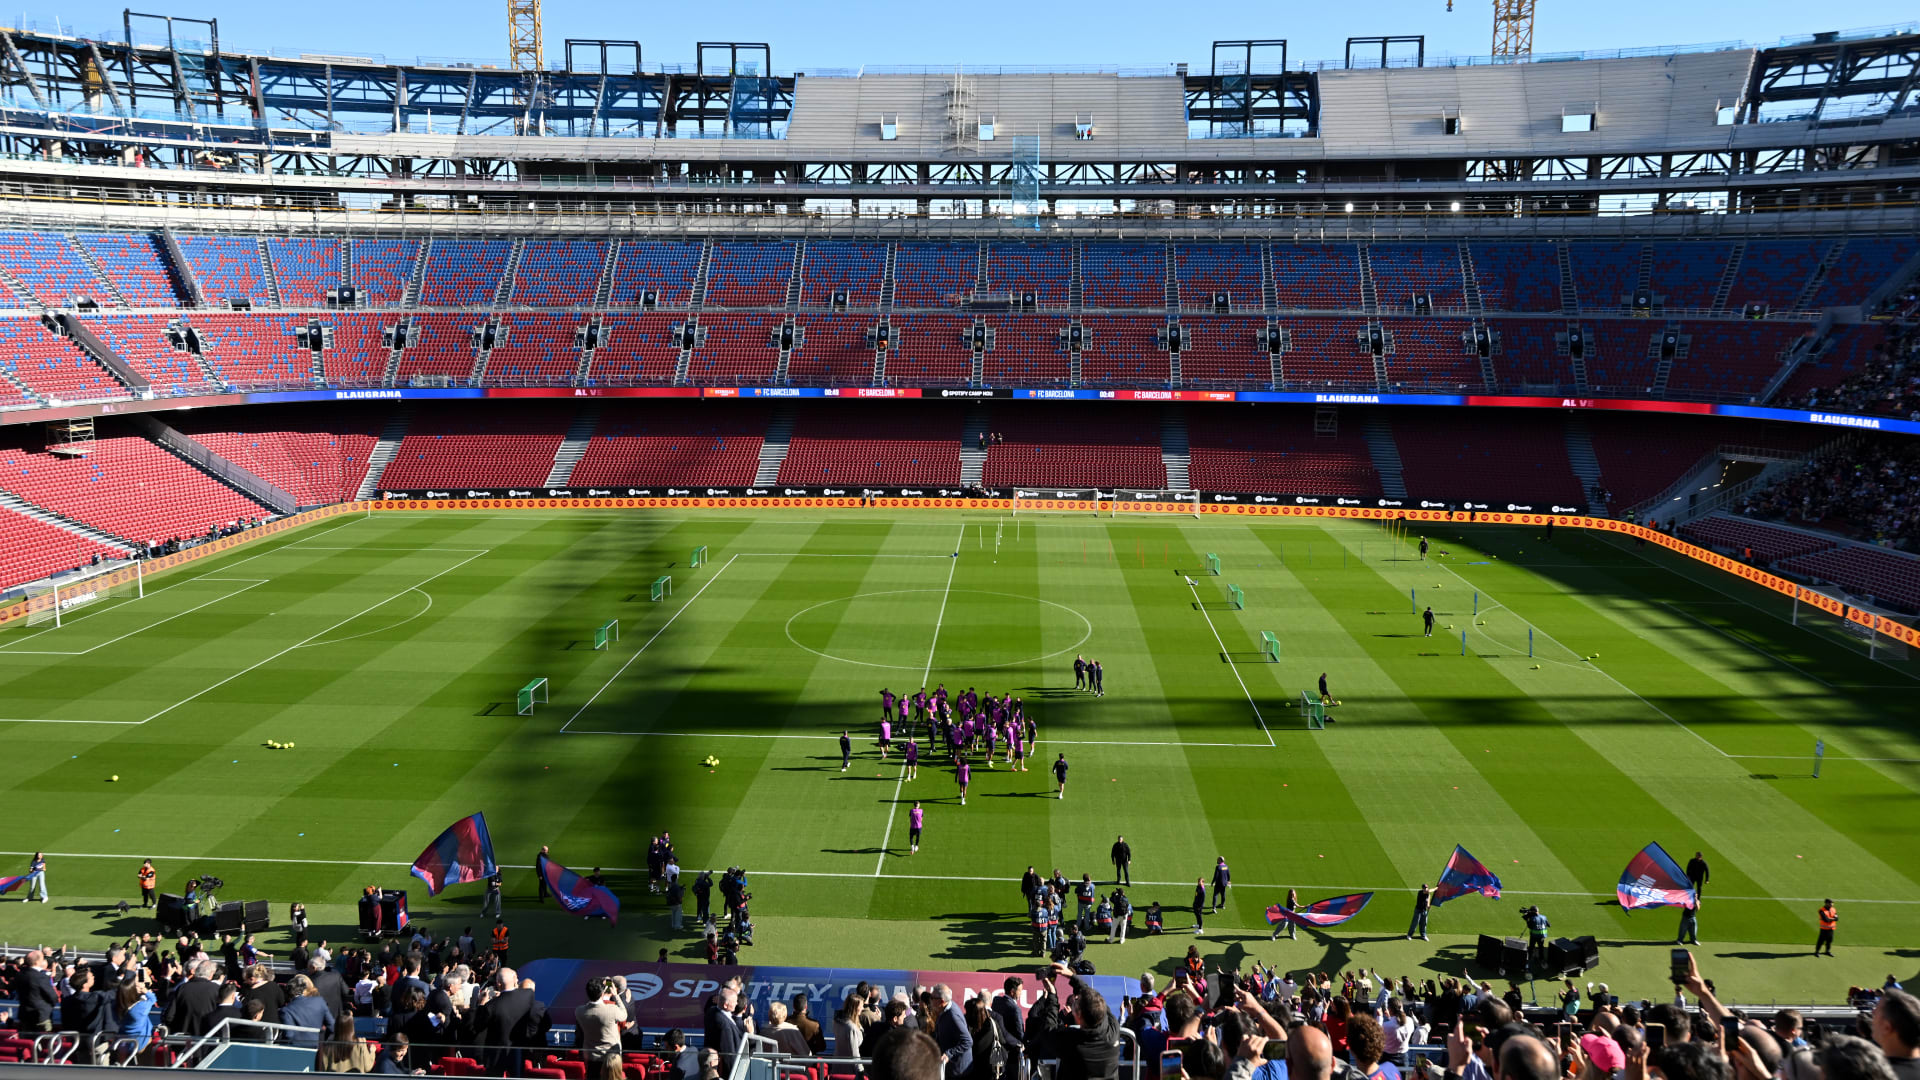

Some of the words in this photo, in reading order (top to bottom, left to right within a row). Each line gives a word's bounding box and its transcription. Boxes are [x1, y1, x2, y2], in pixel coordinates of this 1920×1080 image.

[336, 390, 402, 399] BLAUGRANA
[574, 388, 588, 396] AL
[763, 388, 771, 396] FC
[772, 388, 799, 396] BARCELONA
[858, 388, 868, 397] FC
[868, 388, 895, 397] BARCELONA
[1037, 390, 1045, 398] FC
[1045, 390, 1075, 398] BARCELONA
[1134, 391, 1142, 399] FC
[1142, 391, 1172, 400] BARCELONA
[1315, 394, 1380, 404] BLAUGRANA
[1562, 399, 1577, 407] AL
[1810, 413, 1880, 429] BLAUGRANA
[668, 979, 832, 1001] SPTIFY
